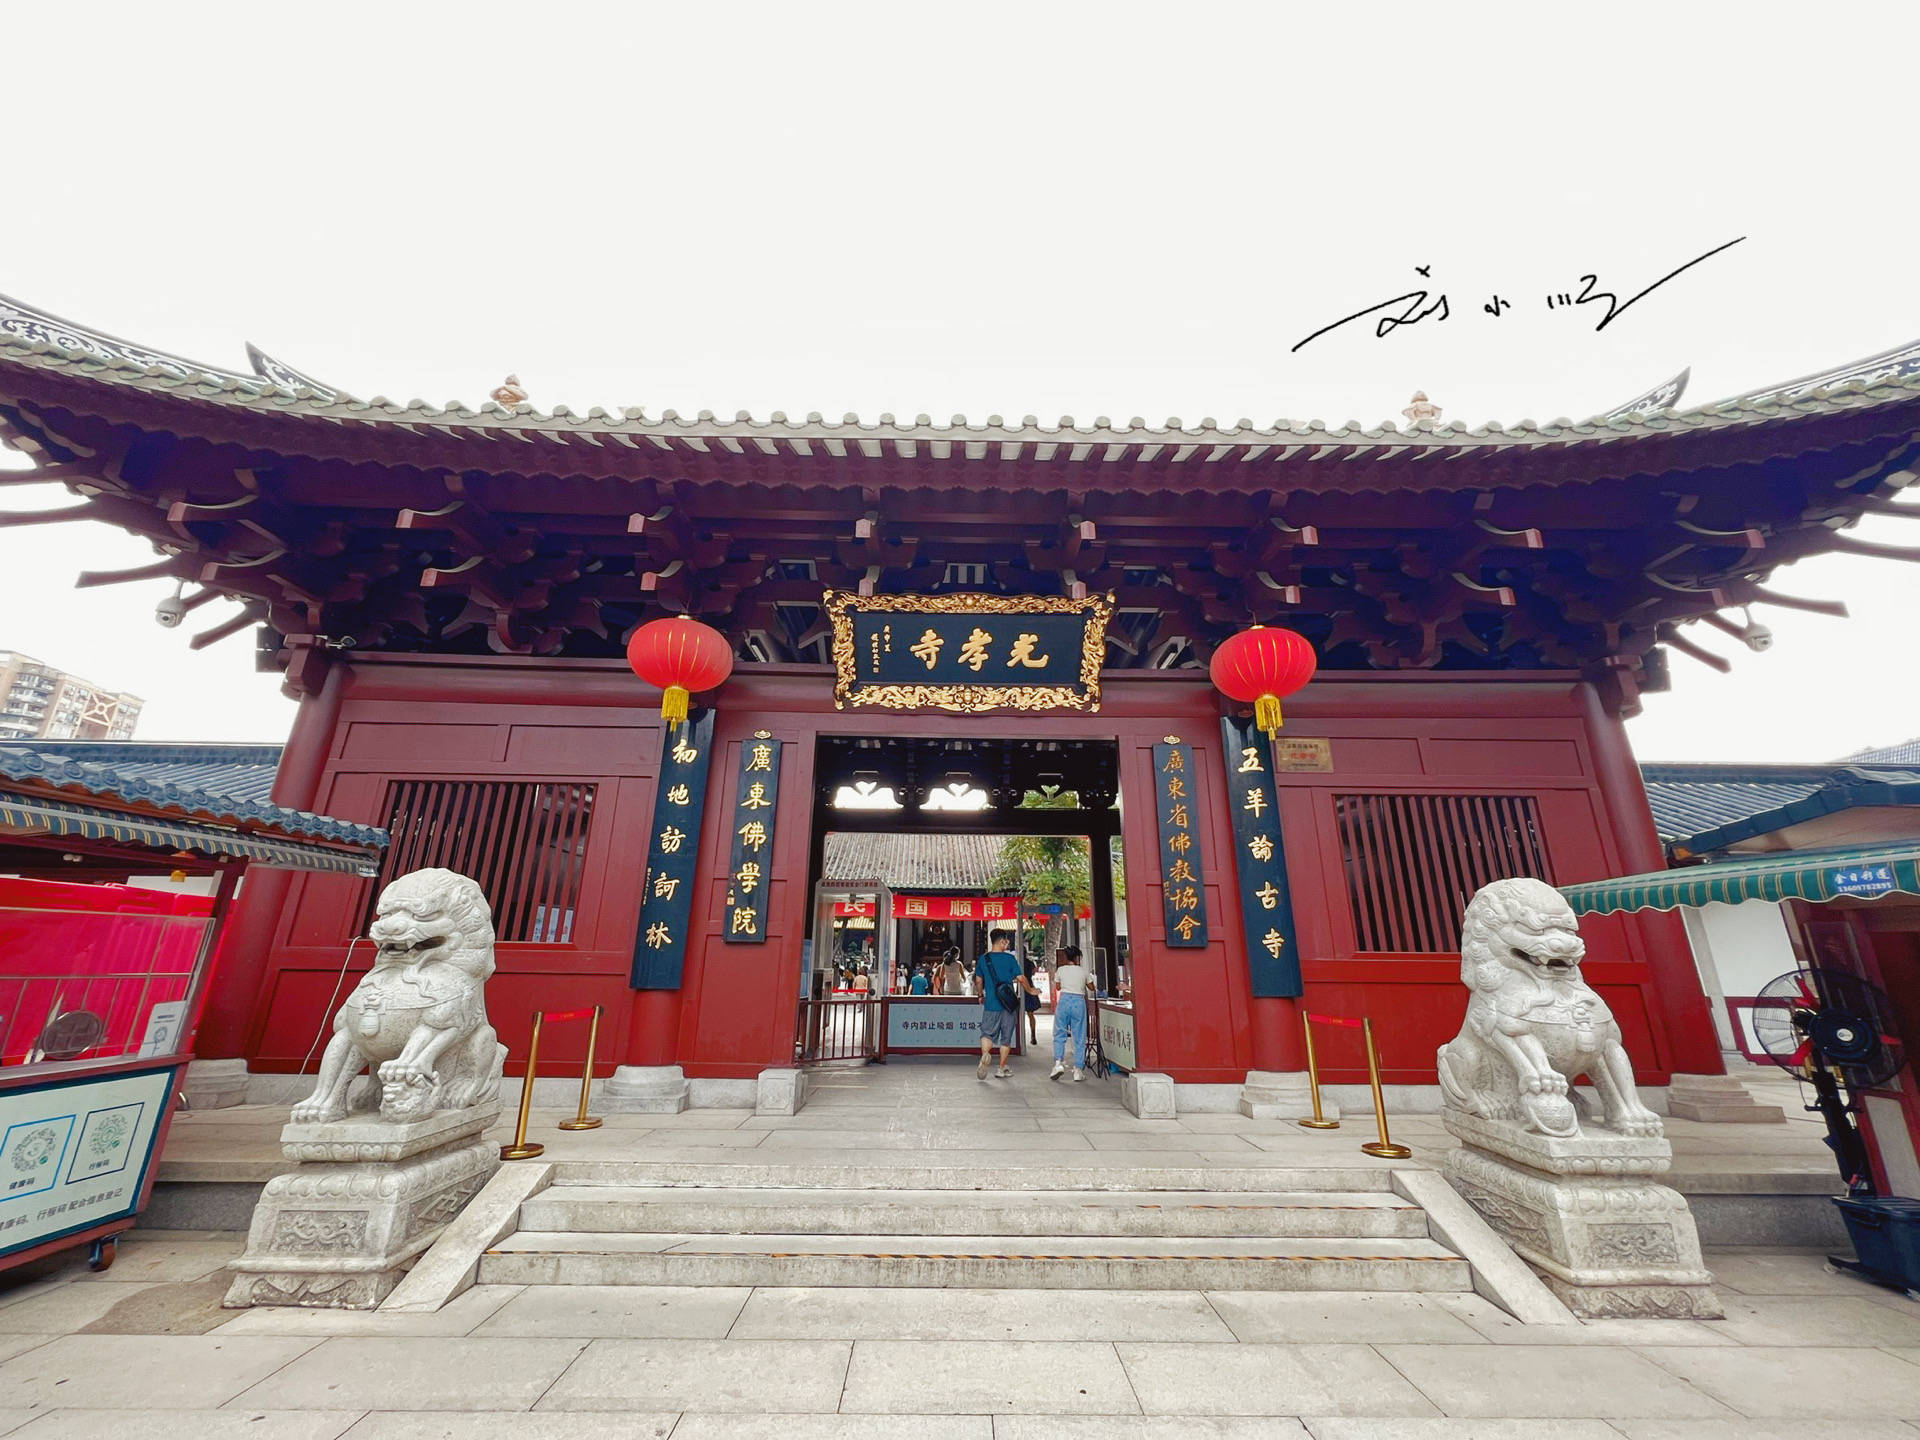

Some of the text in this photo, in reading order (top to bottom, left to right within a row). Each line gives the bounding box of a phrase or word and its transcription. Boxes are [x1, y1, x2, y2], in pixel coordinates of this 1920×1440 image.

[732, 744, 773, 935] 廣東佛學院
[1238, 746, 1286, 960] 五羊論古寺
